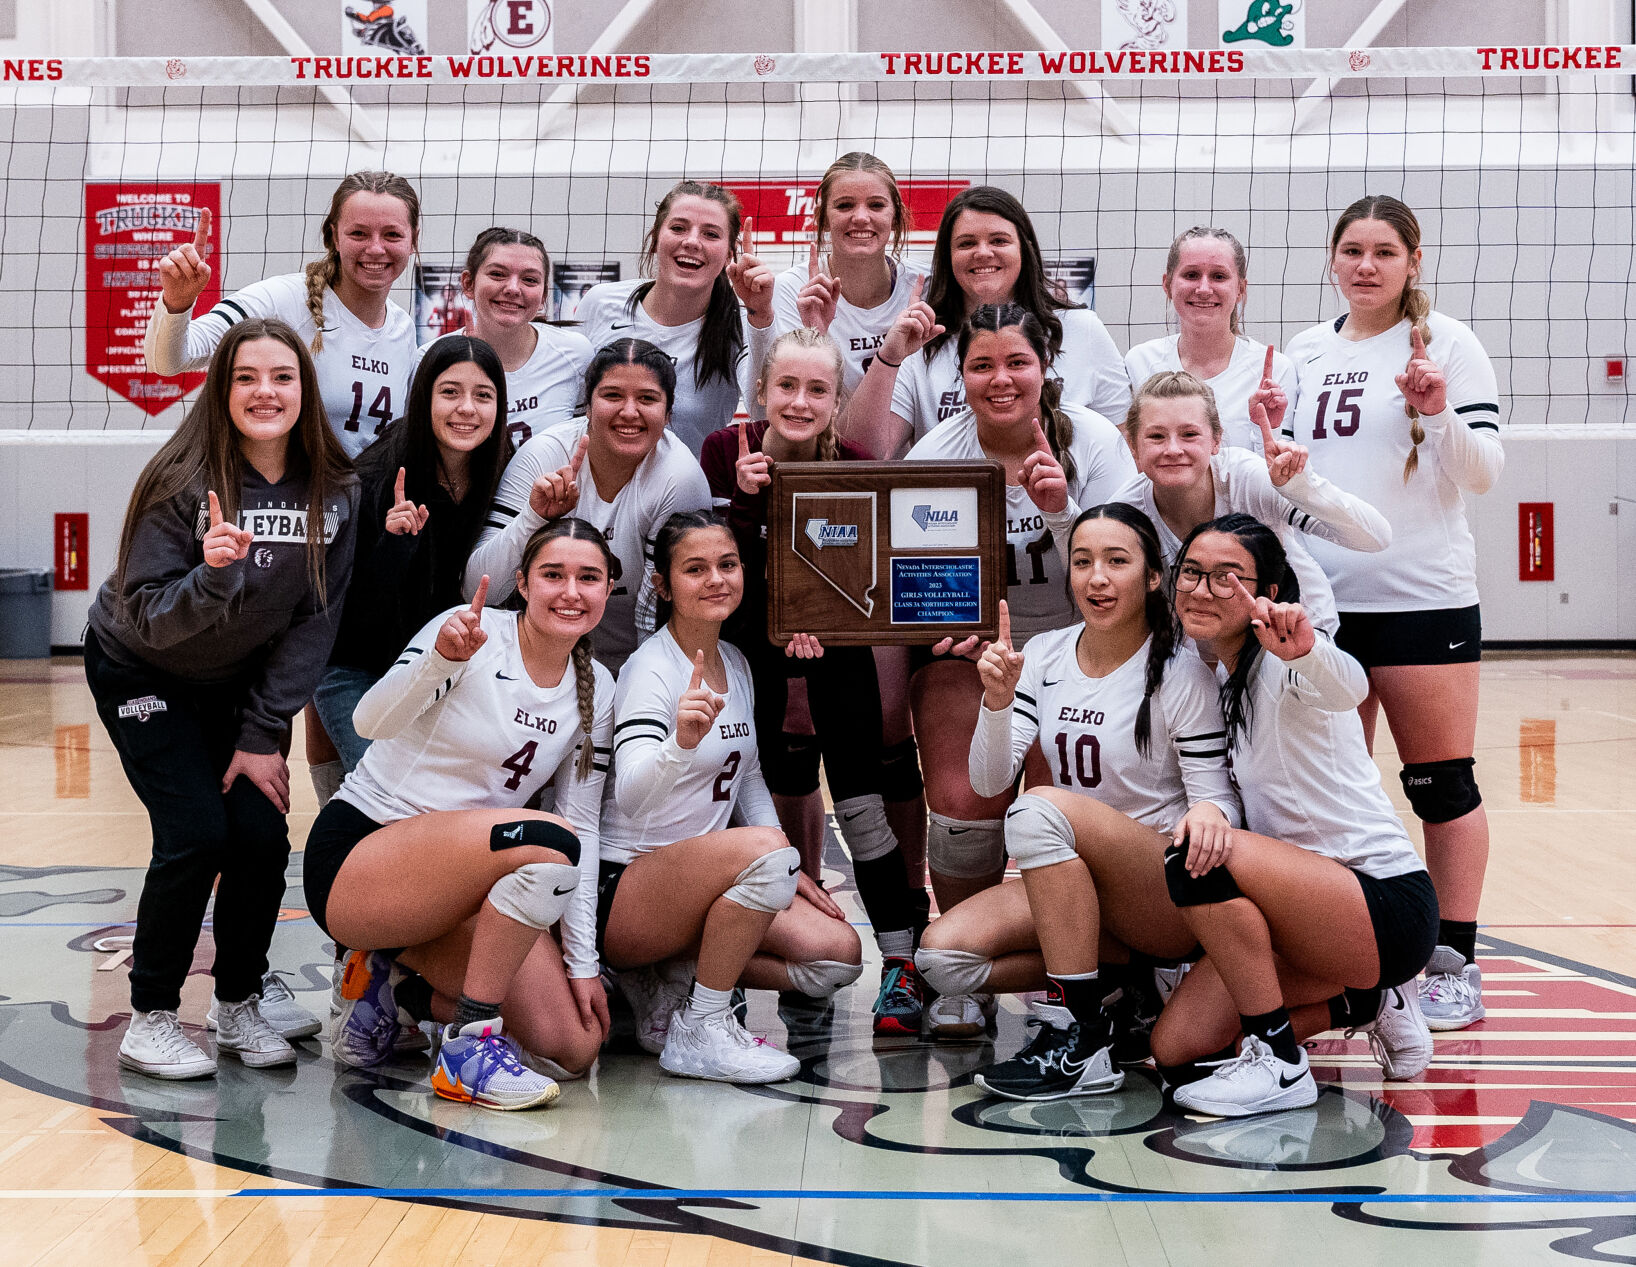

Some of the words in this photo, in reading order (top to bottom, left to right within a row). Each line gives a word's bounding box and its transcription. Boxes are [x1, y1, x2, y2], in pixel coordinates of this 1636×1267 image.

[507, 0, 534, 35] E
[291, 57, 432, 78] TRUCKEE
[447, 56, 650, 78] WOLVERINES
[881, 51, 1025, 74] TRUCKEE
[1039, 50, 1244, 74] WOLVERINES
[1477, 46, 1622, 71] TRUCKEE
[116, 193, 172, 203] WELCOME
[174, 193, 191, 203] TO
[132, 231, 173, 241] WHERE
[351, 354, 389, 376] ELKO
[1322, 371, 1369, 386] ELKO
[343, 380, 394, 435] 14
[506, 396, 538, 413] LKO
[1312, 388, 1365, 440] 15
[926, 510, 958, 522] NIAA
[1007, 514, 1044, 534] LKO
[820, 526, 857, 538] NIAA
[119, 700, 166, 716] VOLLEYBALL
[1058, 706, 1105, 726] ELKO
[514, 708, 558, 735] ELKO
[719, 722, 750, 740] ELKO
[501, 740, 540, 792] 4
[1054, 732, 1103, 788] 10
[712, 750, 742, 803] 2
